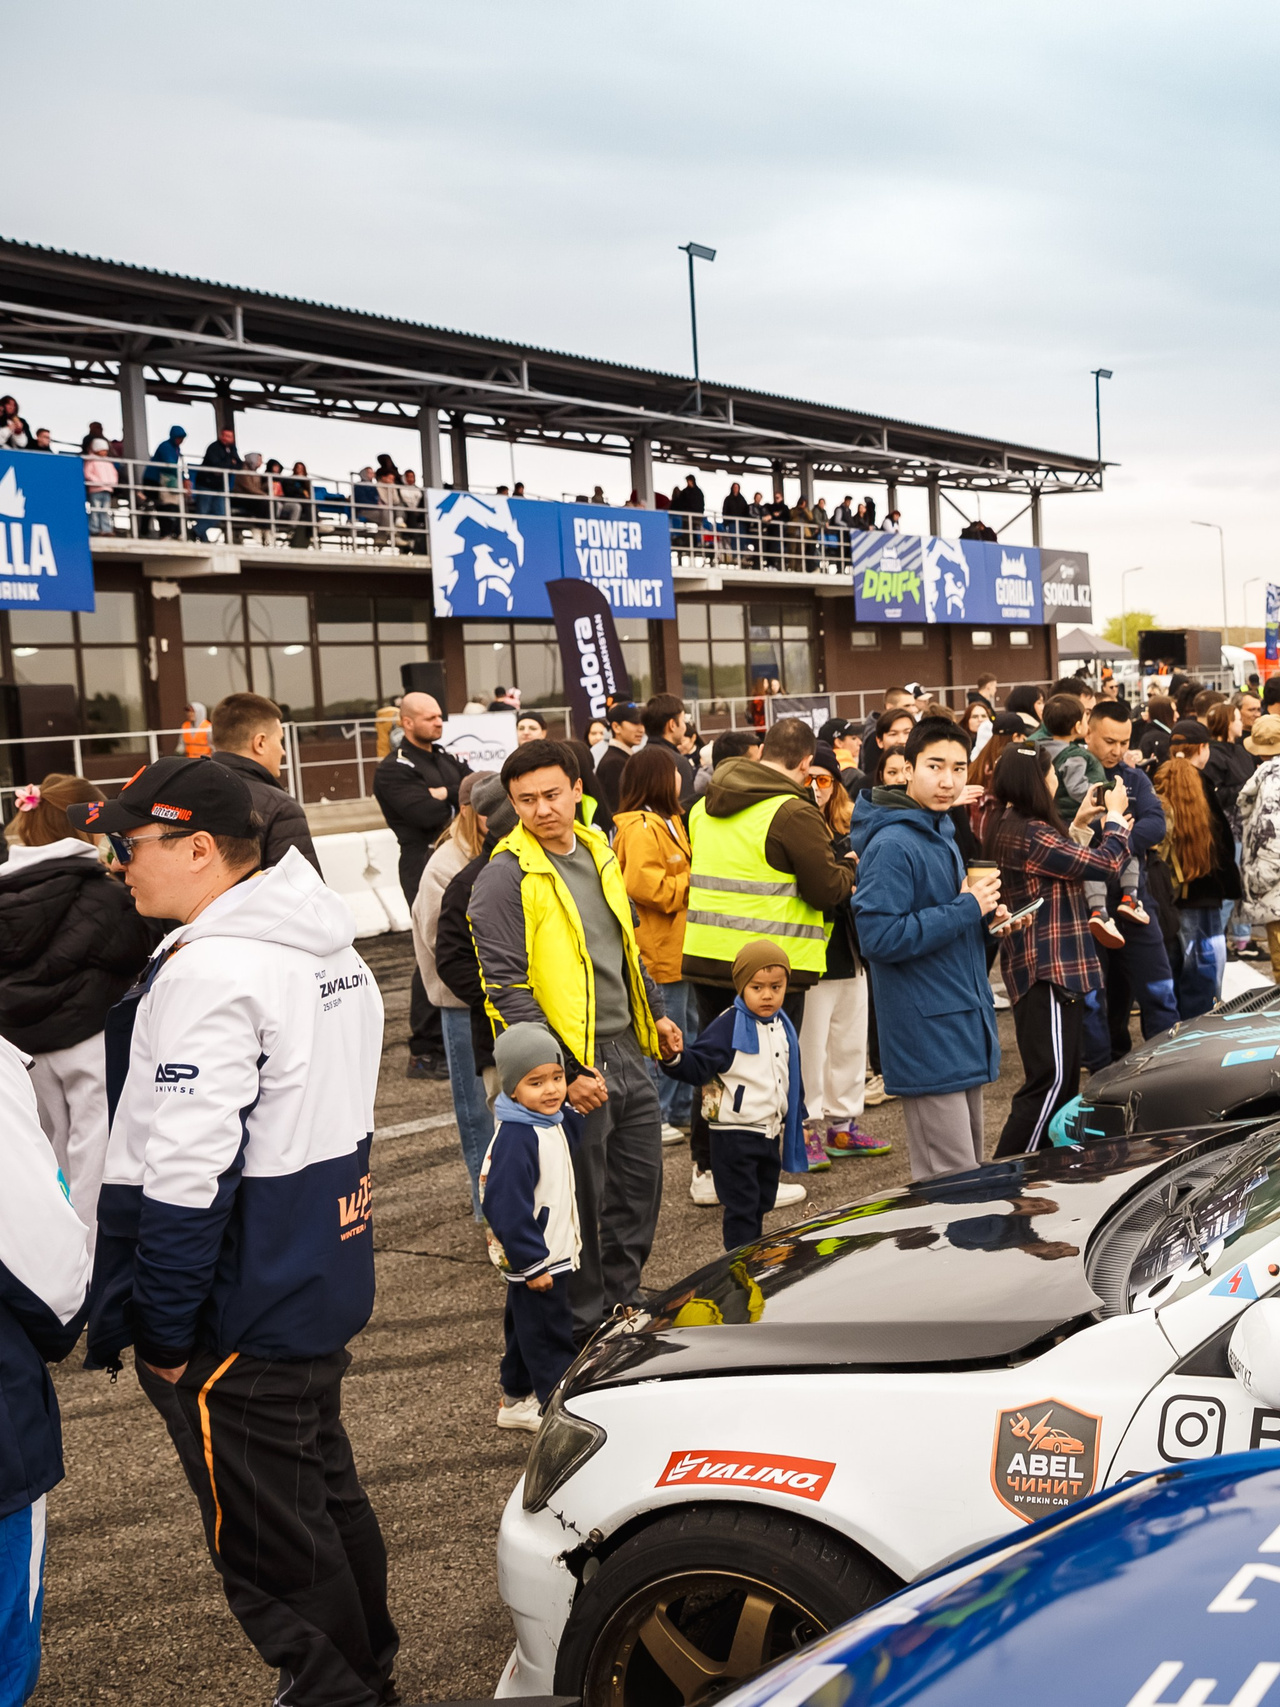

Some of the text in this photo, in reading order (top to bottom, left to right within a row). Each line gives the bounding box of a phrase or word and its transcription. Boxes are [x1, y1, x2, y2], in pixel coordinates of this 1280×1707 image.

[573, 517, 642, 550] POWER
[575, 547, 629, 578] YOUR
[0, 581, 40, 601] RINK
[581, 578, 663, 608] STINCT
[862, 568, 921, 605] DRIFT
[995, 578, 1035, 607] GORILLA
[1043, 581, 1092, 608] SOKOL.KZ
[594, 613, 617, 694] KAZAKHSTAN
[154, 1062, 200, 1083] ASP
[1006, 1452, 1084, 1479] ABEL
[1006, 1475, 1083, 1496] ЧИНИТ
[1014, 1495, 1069, 1506] BY PEKIN CAR
